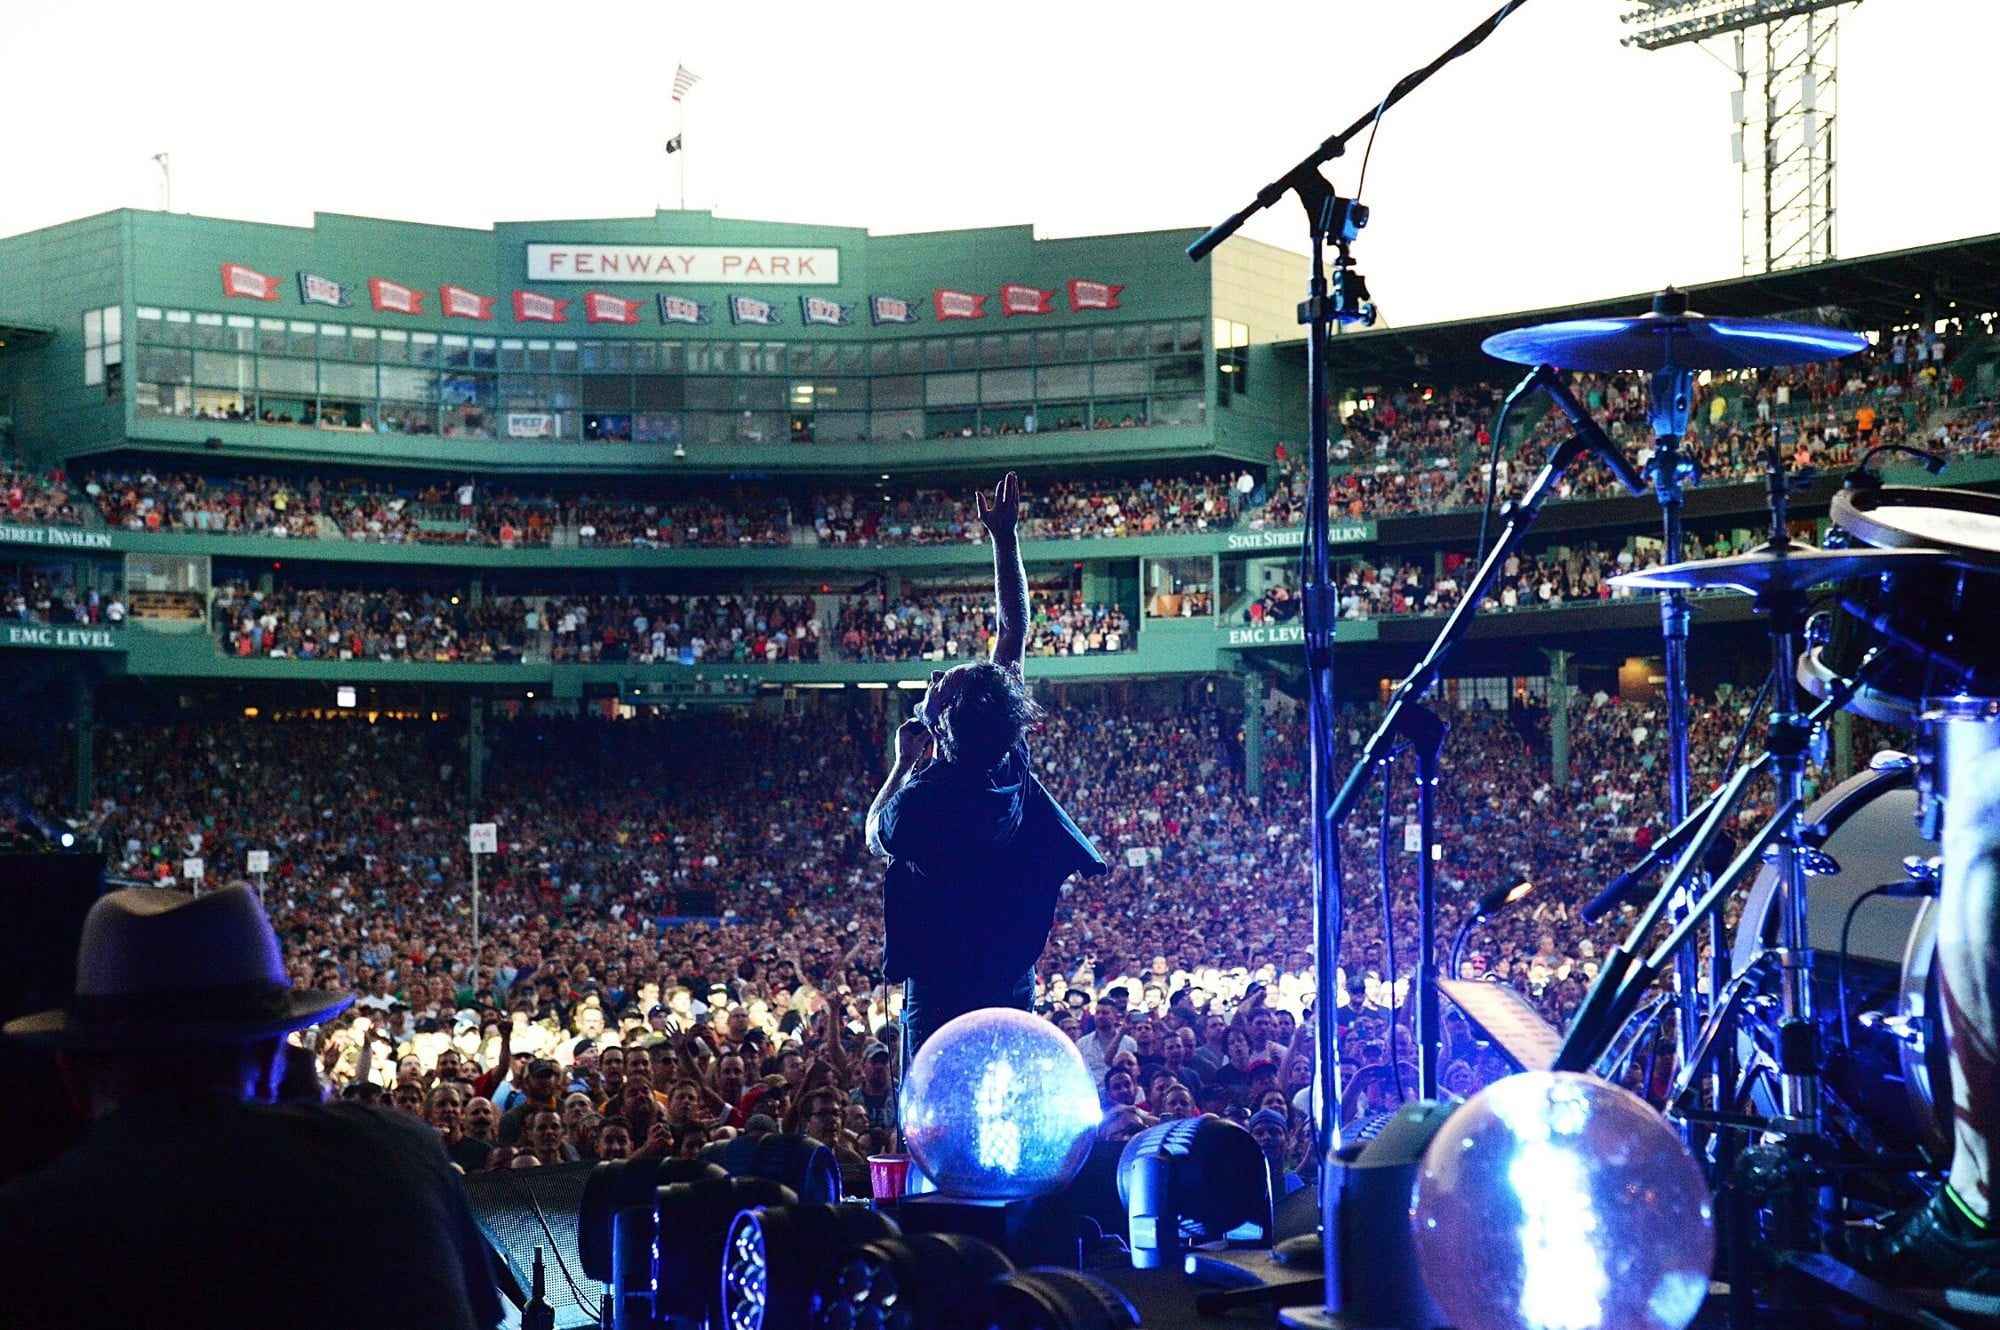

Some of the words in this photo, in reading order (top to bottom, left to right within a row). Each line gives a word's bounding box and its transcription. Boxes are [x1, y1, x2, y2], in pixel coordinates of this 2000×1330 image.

[550, 253, 696, 275] FENWAY
[722, 255, 816, 277] PARK
[48, 527, 112, 548] PAVILION
[1228, 534, 1262, 549] STATE
[10, 628, 51, 644] EMC
[57, 629, 114, 648] LEVEL
[1230, 629, 1264, 644] EMC
[1269, 627, 1305, 642] LEV
